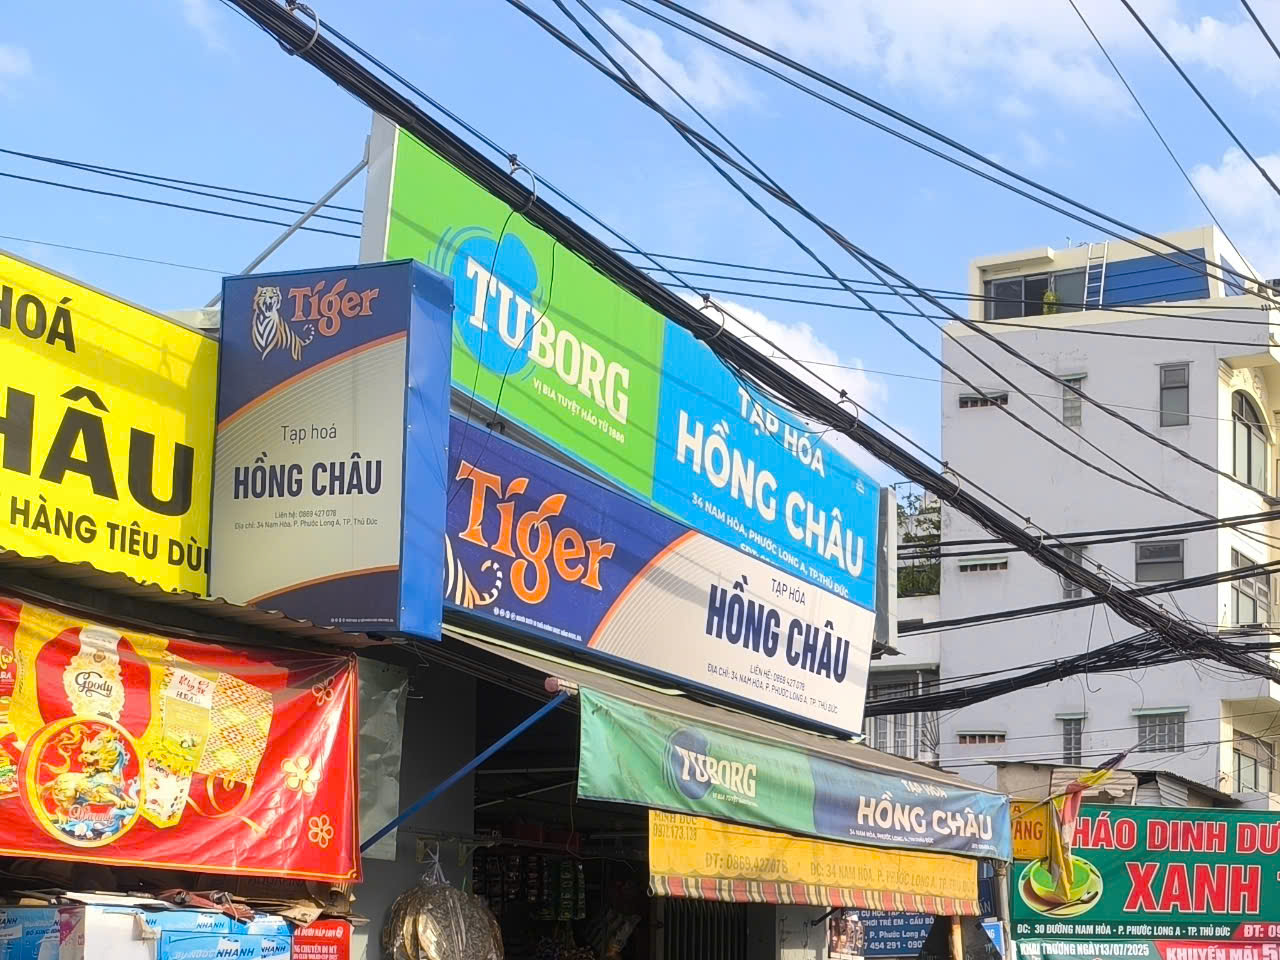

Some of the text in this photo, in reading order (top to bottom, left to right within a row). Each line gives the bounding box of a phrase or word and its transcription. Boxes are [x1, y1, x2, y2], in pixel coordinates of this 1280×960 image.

[287, 277, 380, 338] Tiger
[466, 255, 630, 425] TUBORG
[281, 423, 337, 444] Tạp hoá
[738, 384, 826, 479] TẠP HÓA
[233, 451, 382, 500] HỒNG CHÂU
[676, 409, 864, 578] HỒNG CHÂU
[10, 495, 98, 545] HÀNG
[107, 521, 159, 568] TIÊU
[455, 459, 616, 605] Tiger
[704, 500, 726, 523] NAM
[748, 529, 778, 556] PHƯỚC
[778, 546, 800, 568] LONG
[771, 577, 806, 607] TẠP HÓA
[705, 574, 850, 684] HỒNG CHÂU
[75, 670, 114, 699] Goody
[857, 790, 993, 841] HỒNG CHÂU
[1070, 811, 1137, 850] HÁO
[1146, 817, 1227, 853] DINH
[1122, 860, 1261, 915] XANH
[215, 947, 255, 959] NHANH
[869, 941, 885, 950] 454
[1034, 924, 1044, 934] 30
[1046, 921, 1074, 934] ĐƯỜNG
[1075, 924, 1094, 935] NAM
[1095, 922, 1112, 935] HÒA
[1126, 923, 1152, 936] PHƯỚC
[1153, 925, 1174, 936] LONG
[1174, 925, 1181, 936] A
[1200, 924, 1214, 937] THỦ
[1214, 923, 1231, 937] ĐỨC
[1243, 924, 1264, 938] ĐT:
